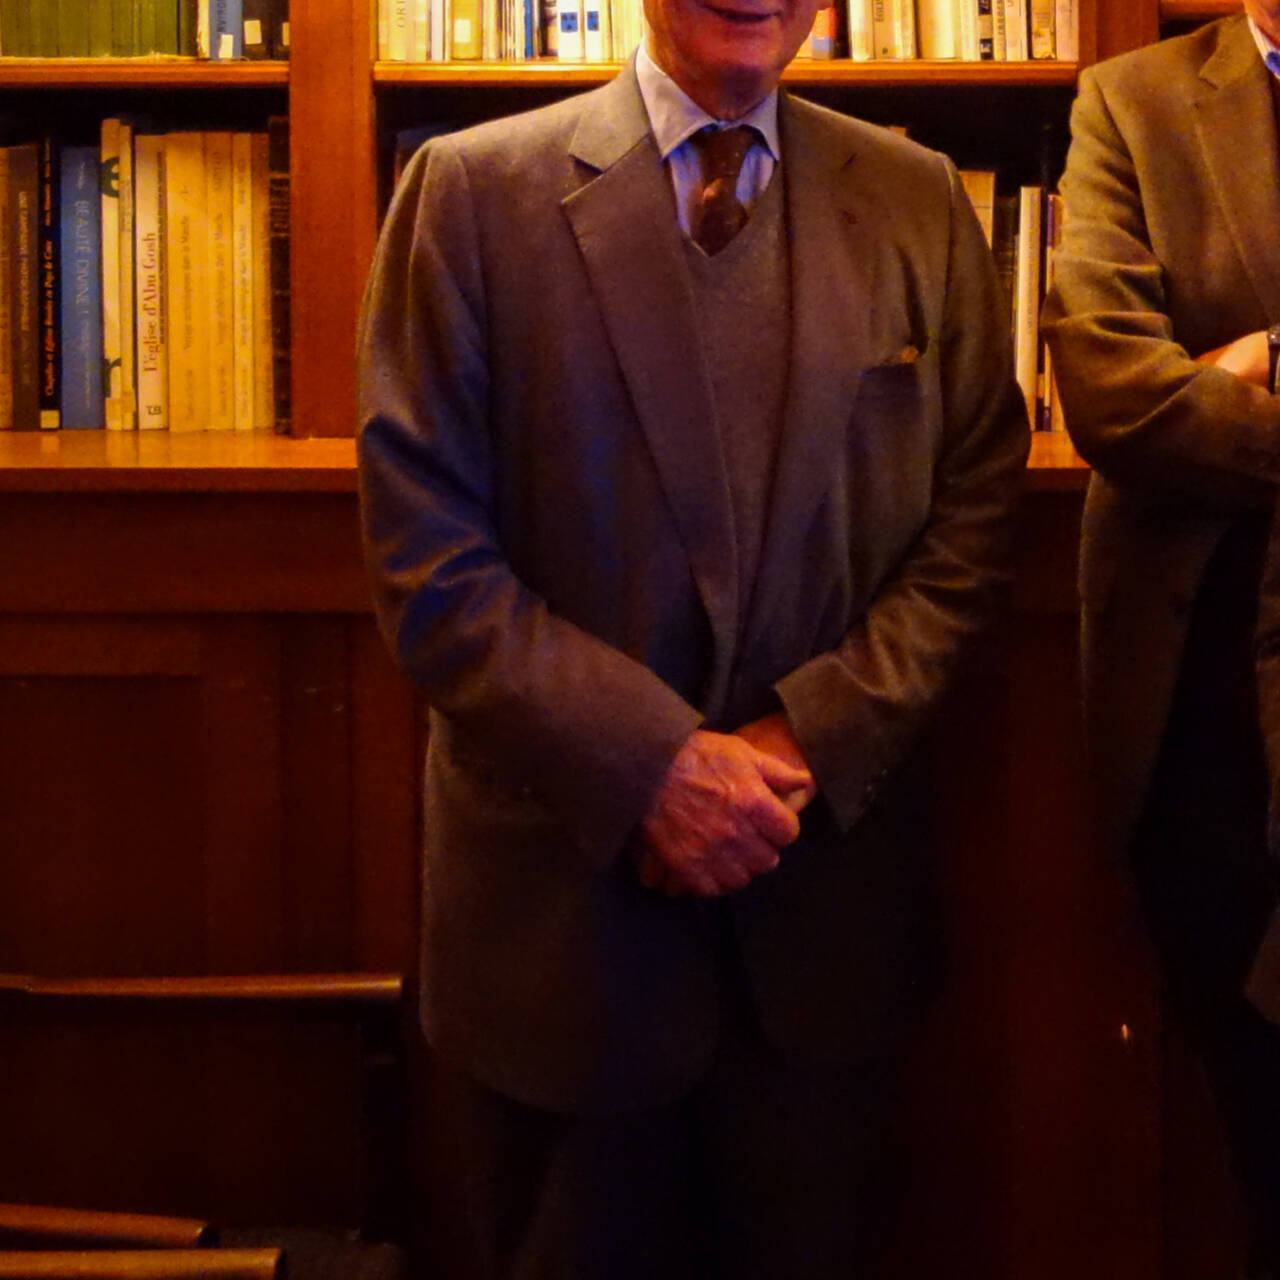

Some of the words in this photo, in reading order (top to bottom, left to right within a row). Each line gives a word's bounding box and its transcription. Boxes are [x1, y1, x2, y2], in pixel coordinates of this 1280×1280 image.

[141, 231, 156, 270] Gosh
[142, 274, 157, 316] d'Abu
[141, 321, 160, 372] L'église
